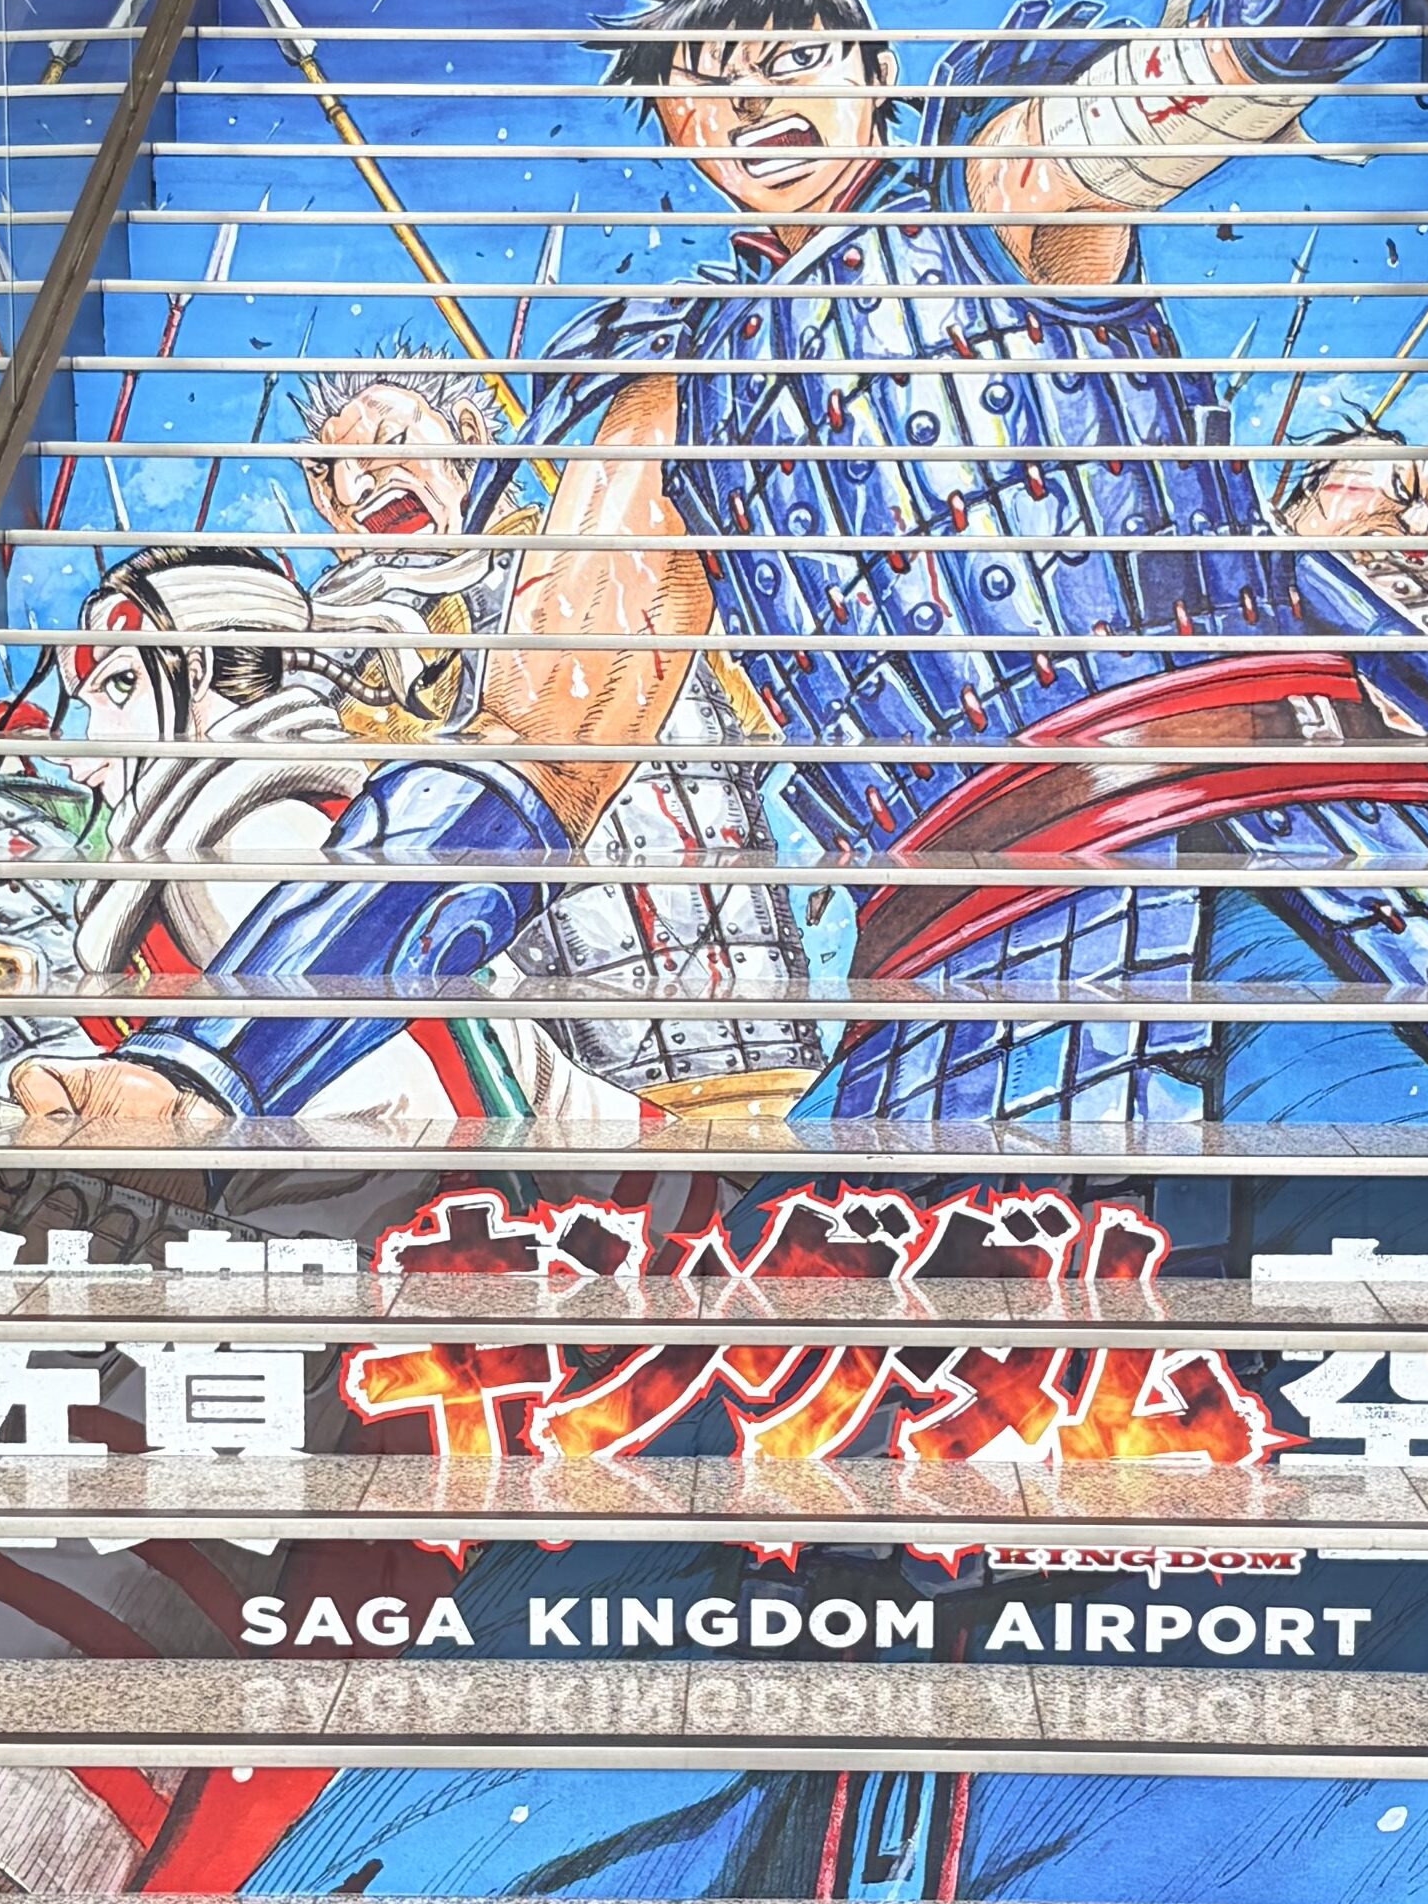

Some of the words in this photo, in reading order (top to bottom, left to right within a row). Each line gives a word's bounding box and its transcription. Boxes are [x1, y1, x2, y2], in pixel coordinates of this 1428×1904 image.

[990, 1545, 1302, 1572] KINGDOM
[241, 1596, 475, 1647] SAGA
[529, 1597, 936, 1650] KINGDOM
[985, 1601, 1372, 1657] AIRPORT
